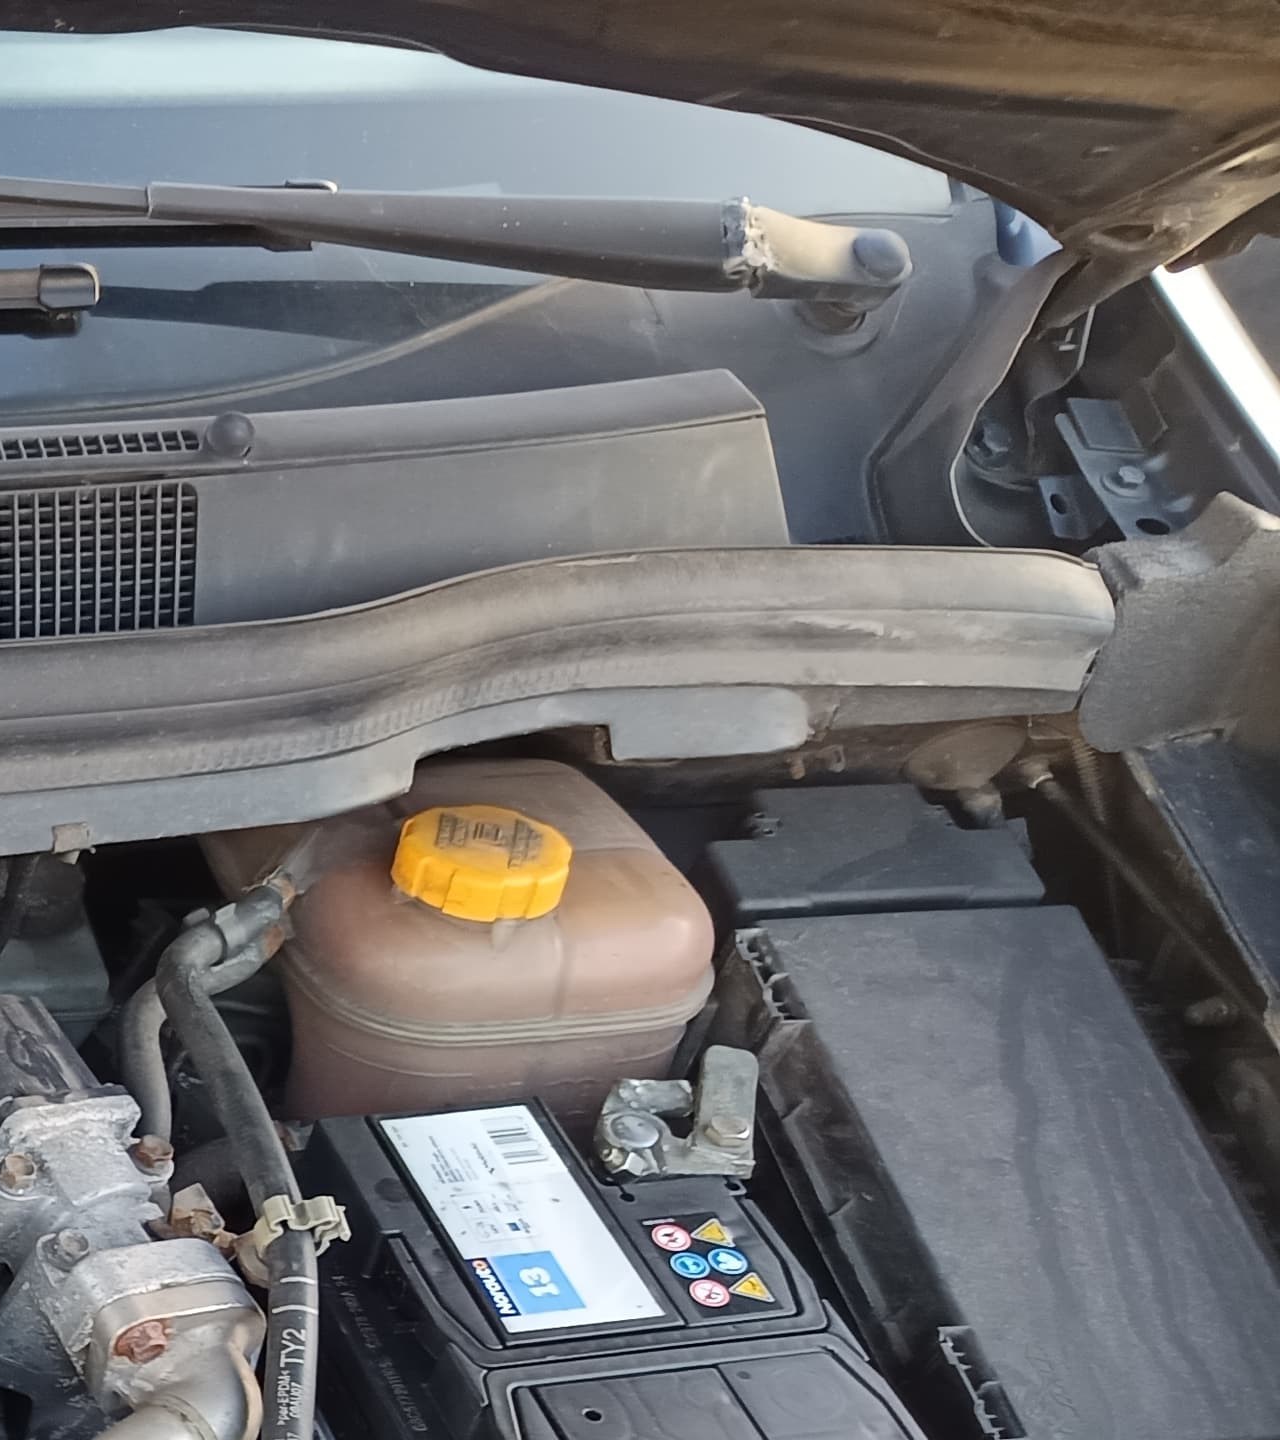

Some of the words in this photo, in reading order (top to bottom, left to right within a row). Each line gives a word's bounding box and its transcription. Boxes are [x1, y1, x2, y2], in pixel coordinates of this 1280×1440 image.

[471, 1259, 518, 1315] Norauto
[519, 1265, 560, 1297] 13
[279, 1327, 308, 1369] TY2
